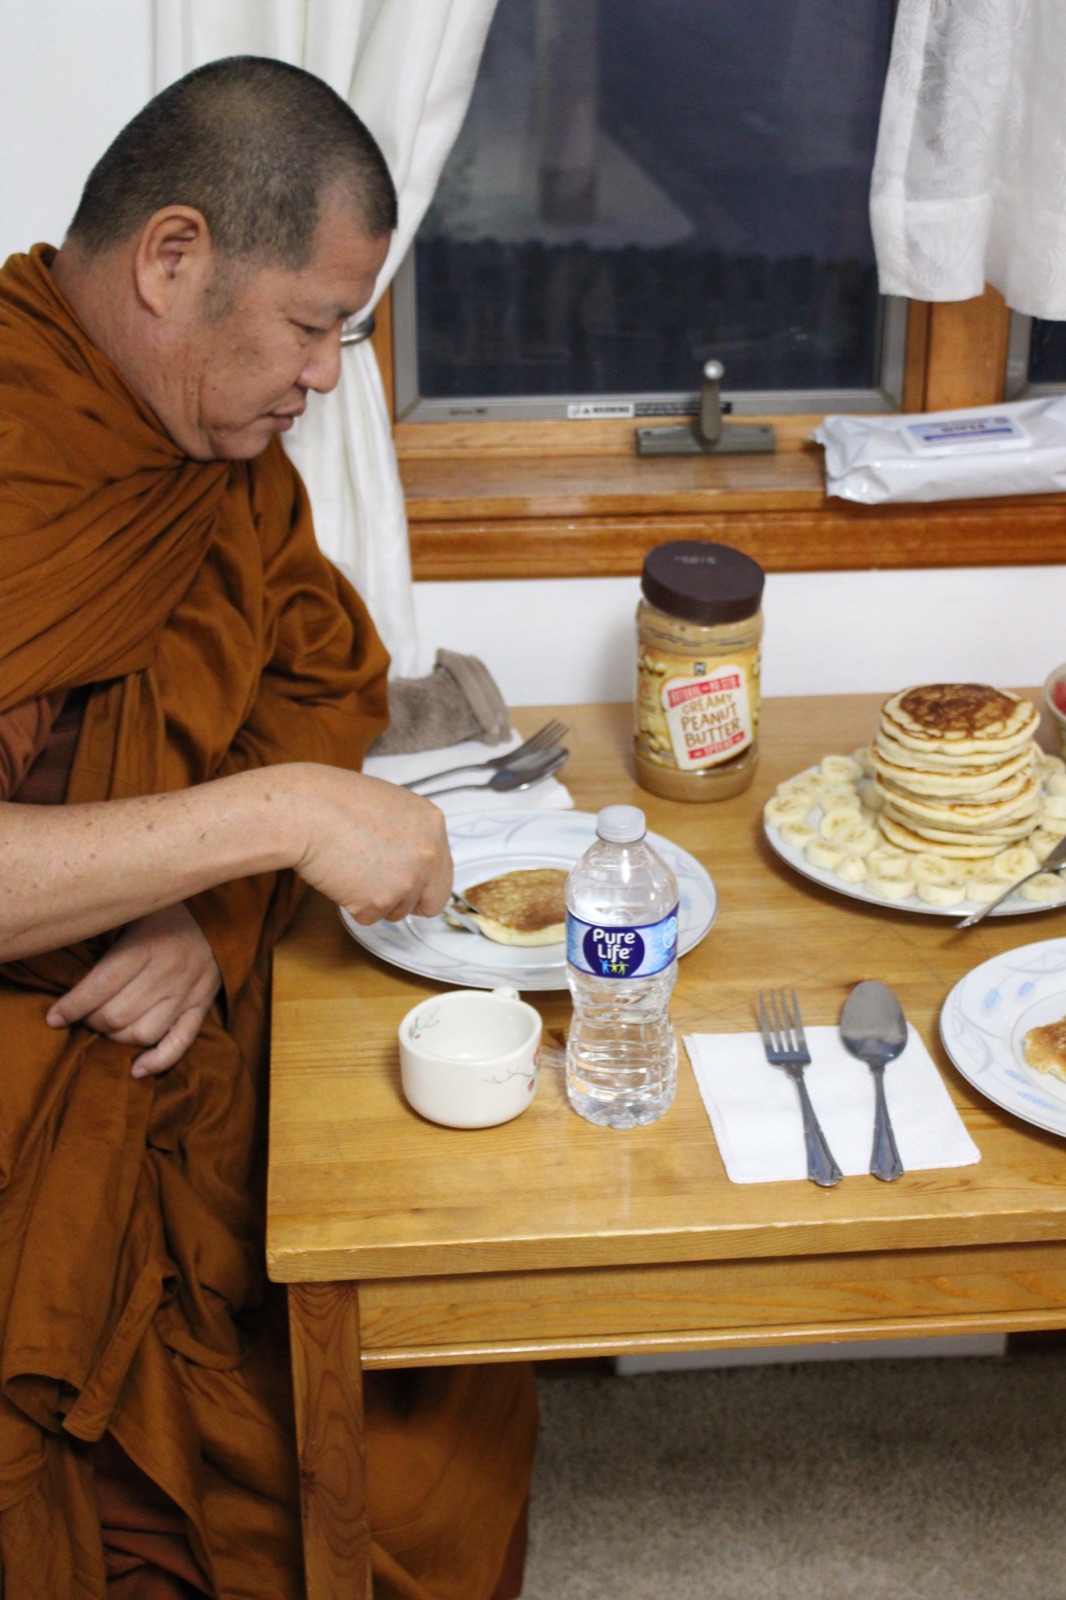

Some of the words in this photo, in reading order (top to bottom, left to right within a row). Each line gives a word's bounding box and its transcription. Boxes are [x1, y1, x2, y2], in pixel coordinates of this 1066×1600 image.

[681, 692, 733, 715] CREAMY
[680, 702, 737, 732] PEANUT
[684, 718, 740, 748] BUTTER
[592, 928, 636, 945] Pure
[597, 943, 631, 963] Life
